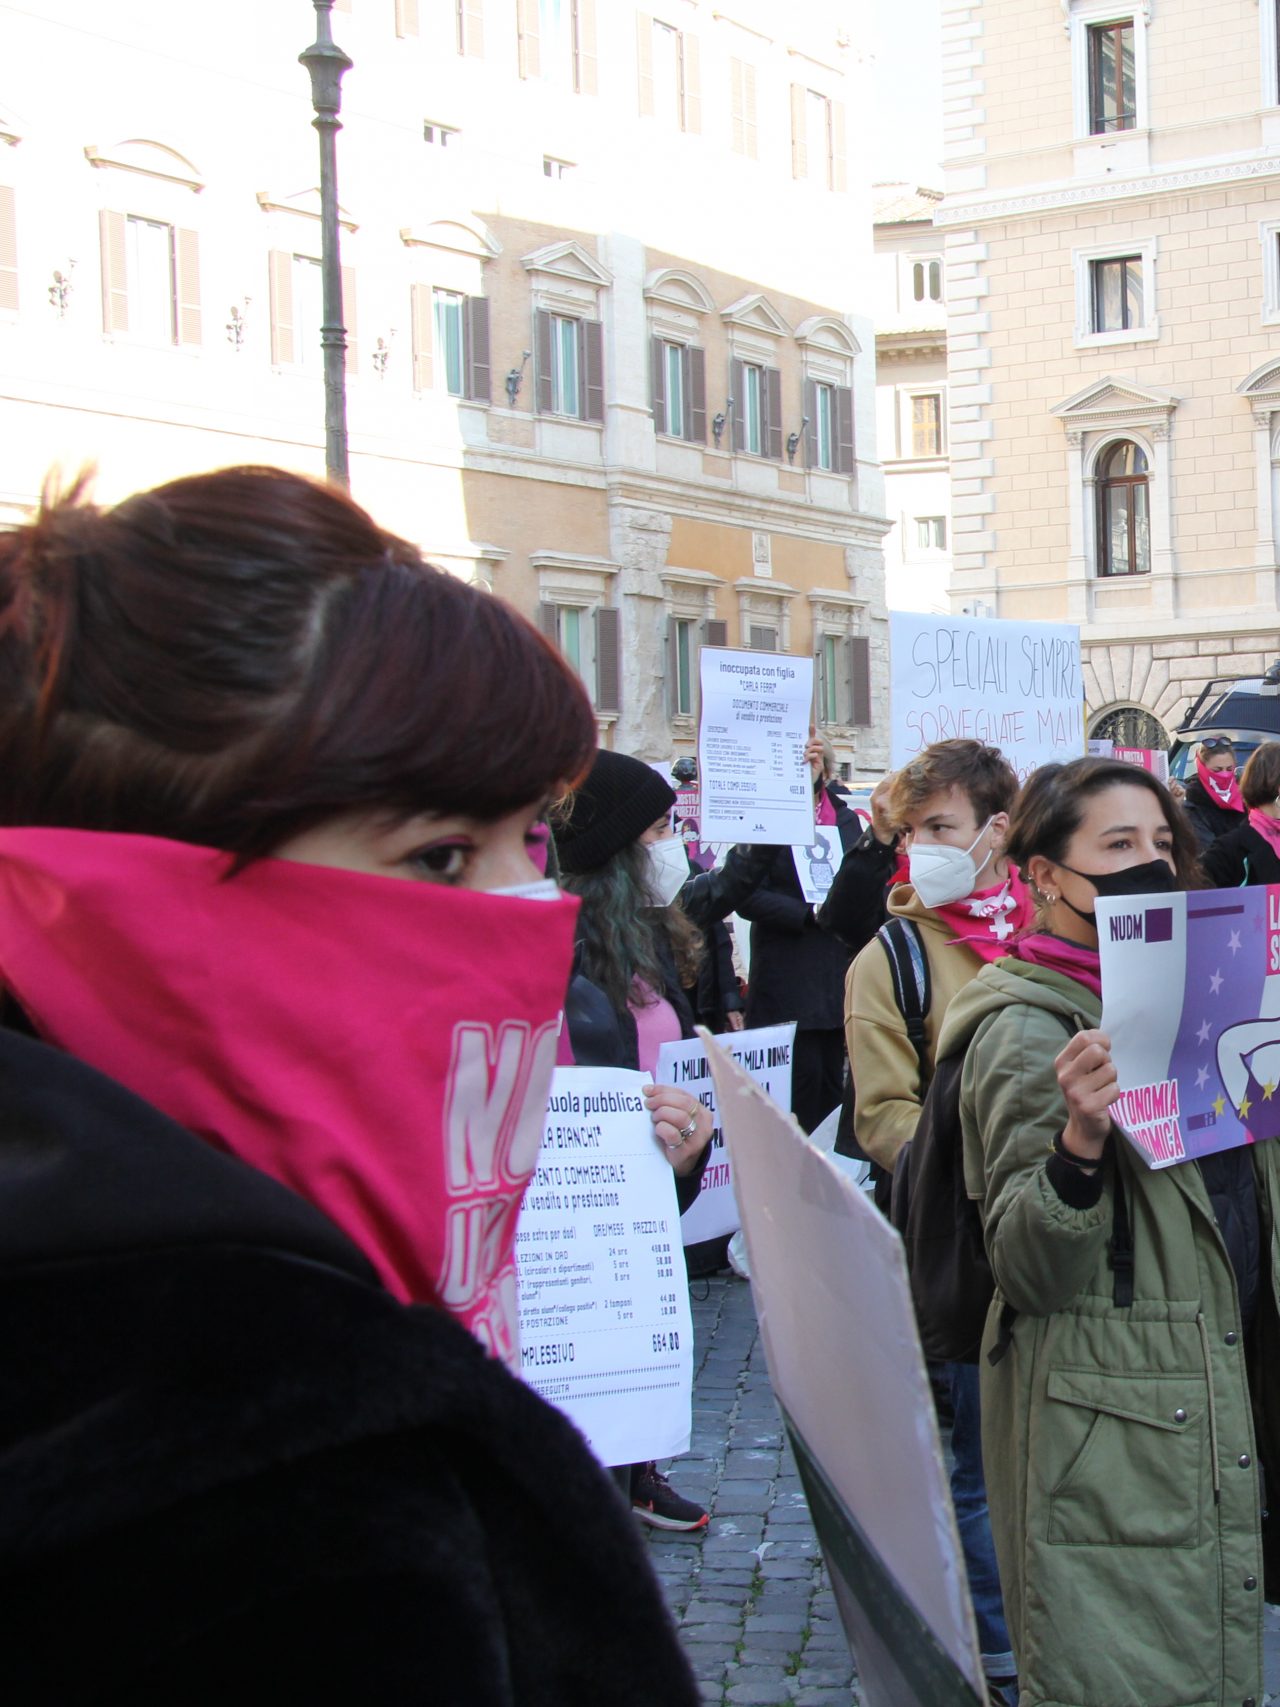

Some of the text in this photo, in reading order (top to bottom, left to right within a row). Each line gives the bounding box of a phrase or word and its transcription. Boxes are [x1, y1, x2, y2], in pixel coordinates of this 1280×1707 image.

[719, 661, 795, 680] inoccupata con figlia
[911, 629, 1077, 700] SPECIALI SEMPRE
[1109, 914, 1143, 942] NUDM
[673, 1061, 678, 1083] 1
[744, 1048, 765, 1071] MILA
[767, 1044, 790, 1068] DONNE
[583, 1092, 643, 1117] pubblica
[699, 1091, 716, 1112] NEL
[528, 1164, 626, 1187] MENTO COMMERCIALE
[701, 1163, 730, 1190] STATA
[632, 1220, 657, 1235] PREZZO
[526, 1316, 569, 1329] POSTAZIONE
[521, 1342, 575, 1367] MPLESSIVO
[652, 1332, 680, 1353] 664,00
